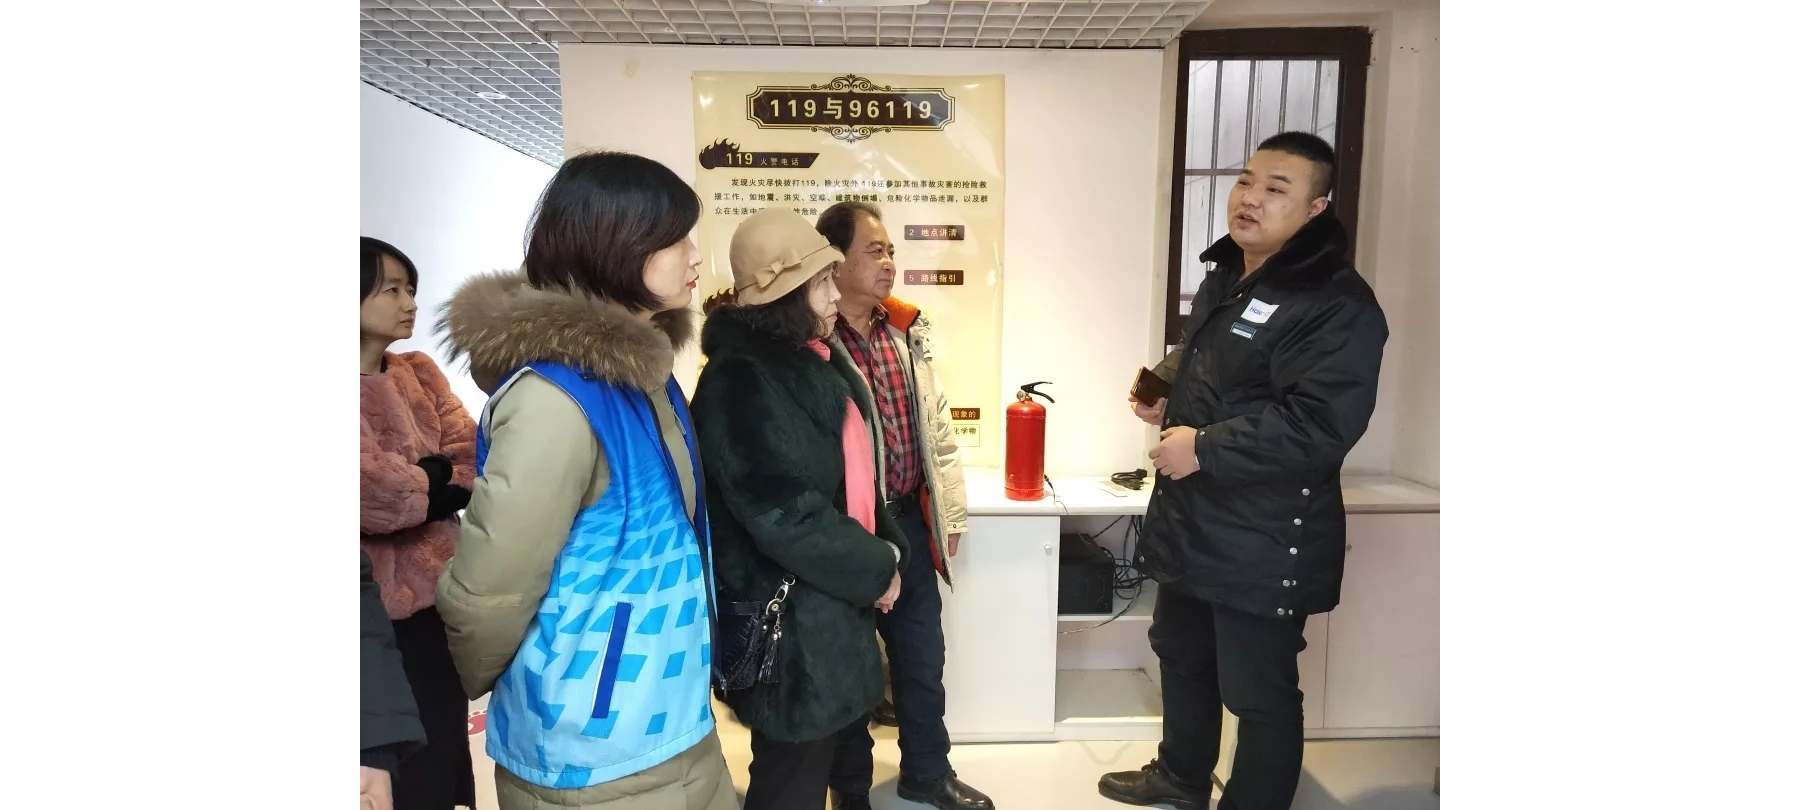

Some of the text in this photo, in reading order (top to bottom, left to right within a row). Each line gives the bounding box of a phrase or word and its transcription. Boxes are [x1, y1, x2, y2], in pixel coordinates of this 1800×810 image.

[770, 97, 932, 119] 119与96119
[726, 152, 799, 166] 119 火警电话
[909, 228, 957, 237] 2 地点讲清
[909, 274, 956, 282] 5 路线指引
[952, 410, 976, 418] 现象的
